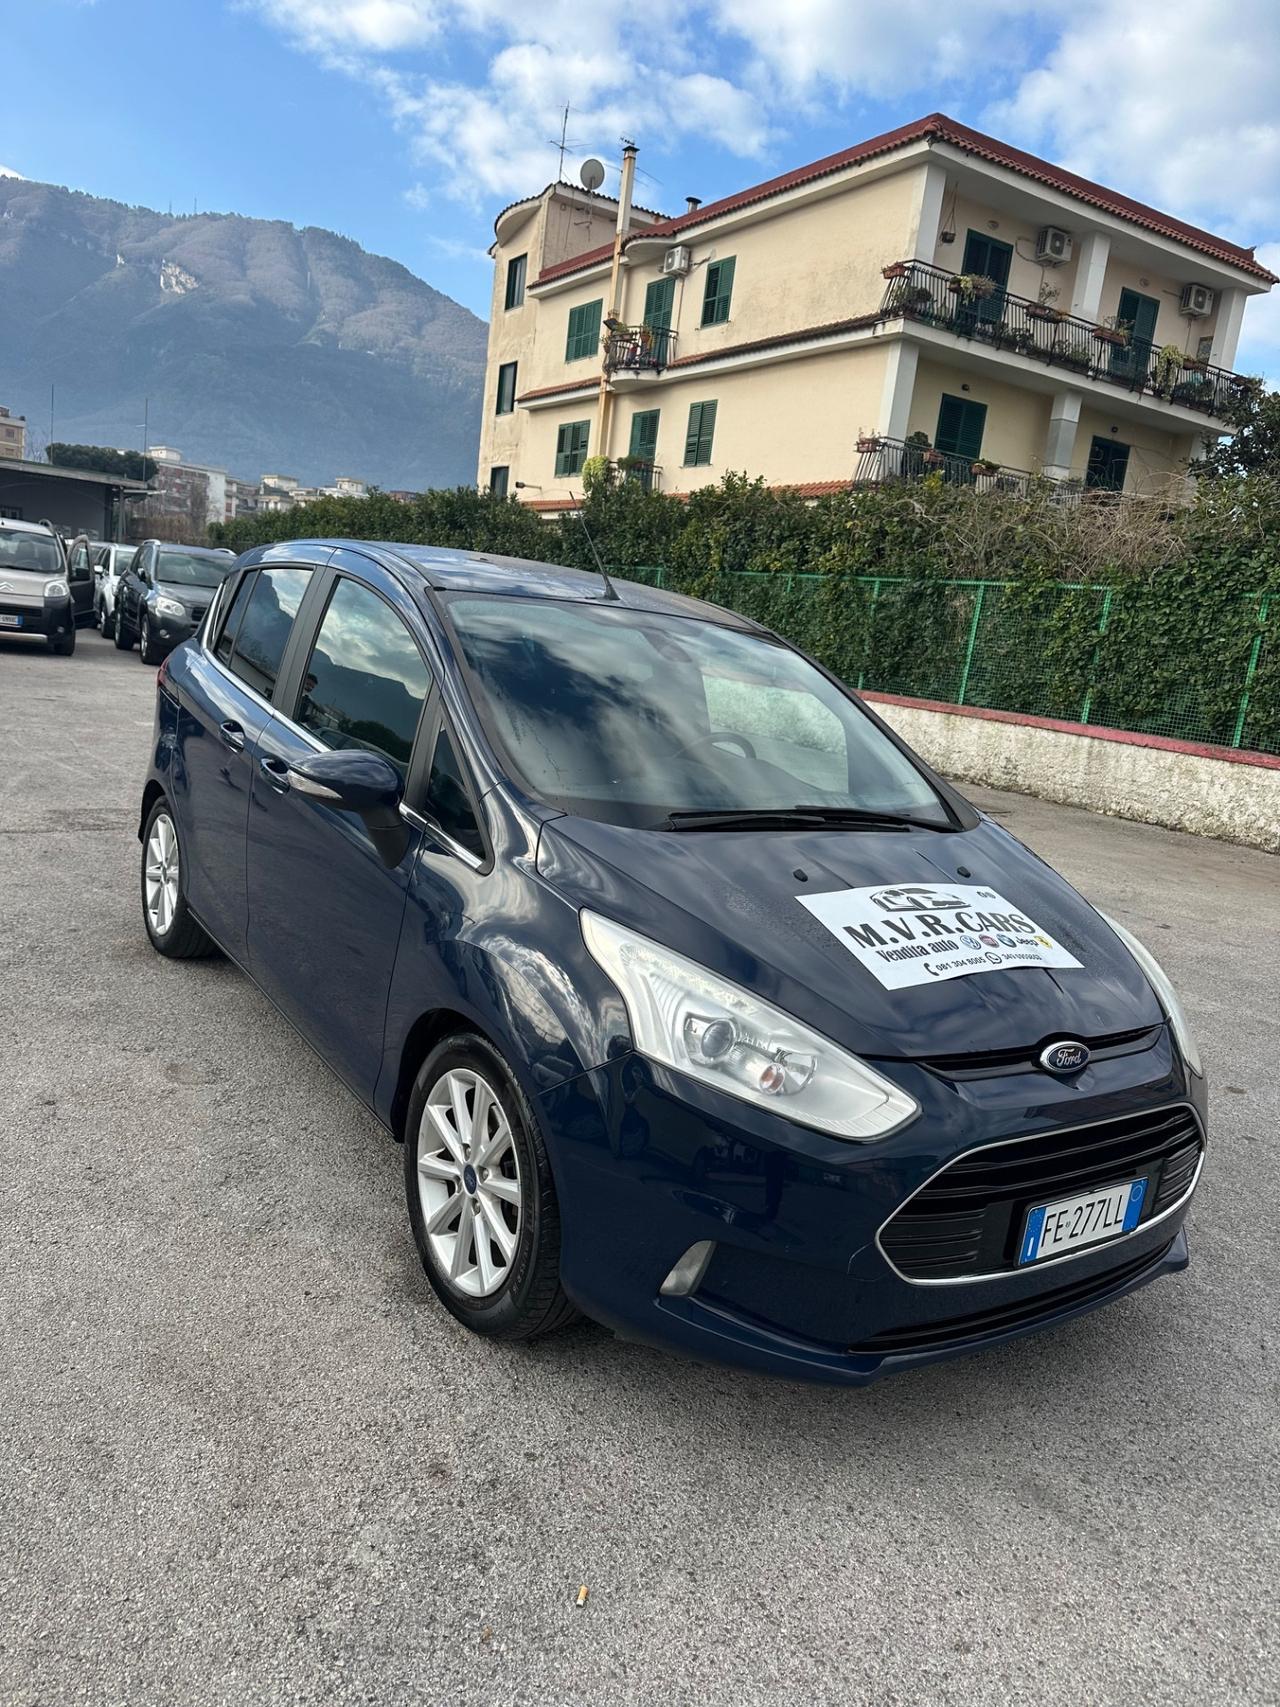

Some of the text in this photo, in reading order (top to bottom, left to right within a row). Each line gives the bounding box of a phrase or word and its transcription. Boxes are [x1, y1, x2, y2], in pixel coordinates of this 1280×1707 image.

[842, 911, 1036, 949] M.V.R.CARS
[875, 944, 931, 963] Vendita
[927, 939, 960, 954] auto
[935, 962, 953, 972] 081
[953, 959, 966, 967] 304
[1056, 1048, 1081, 1067] Ford
